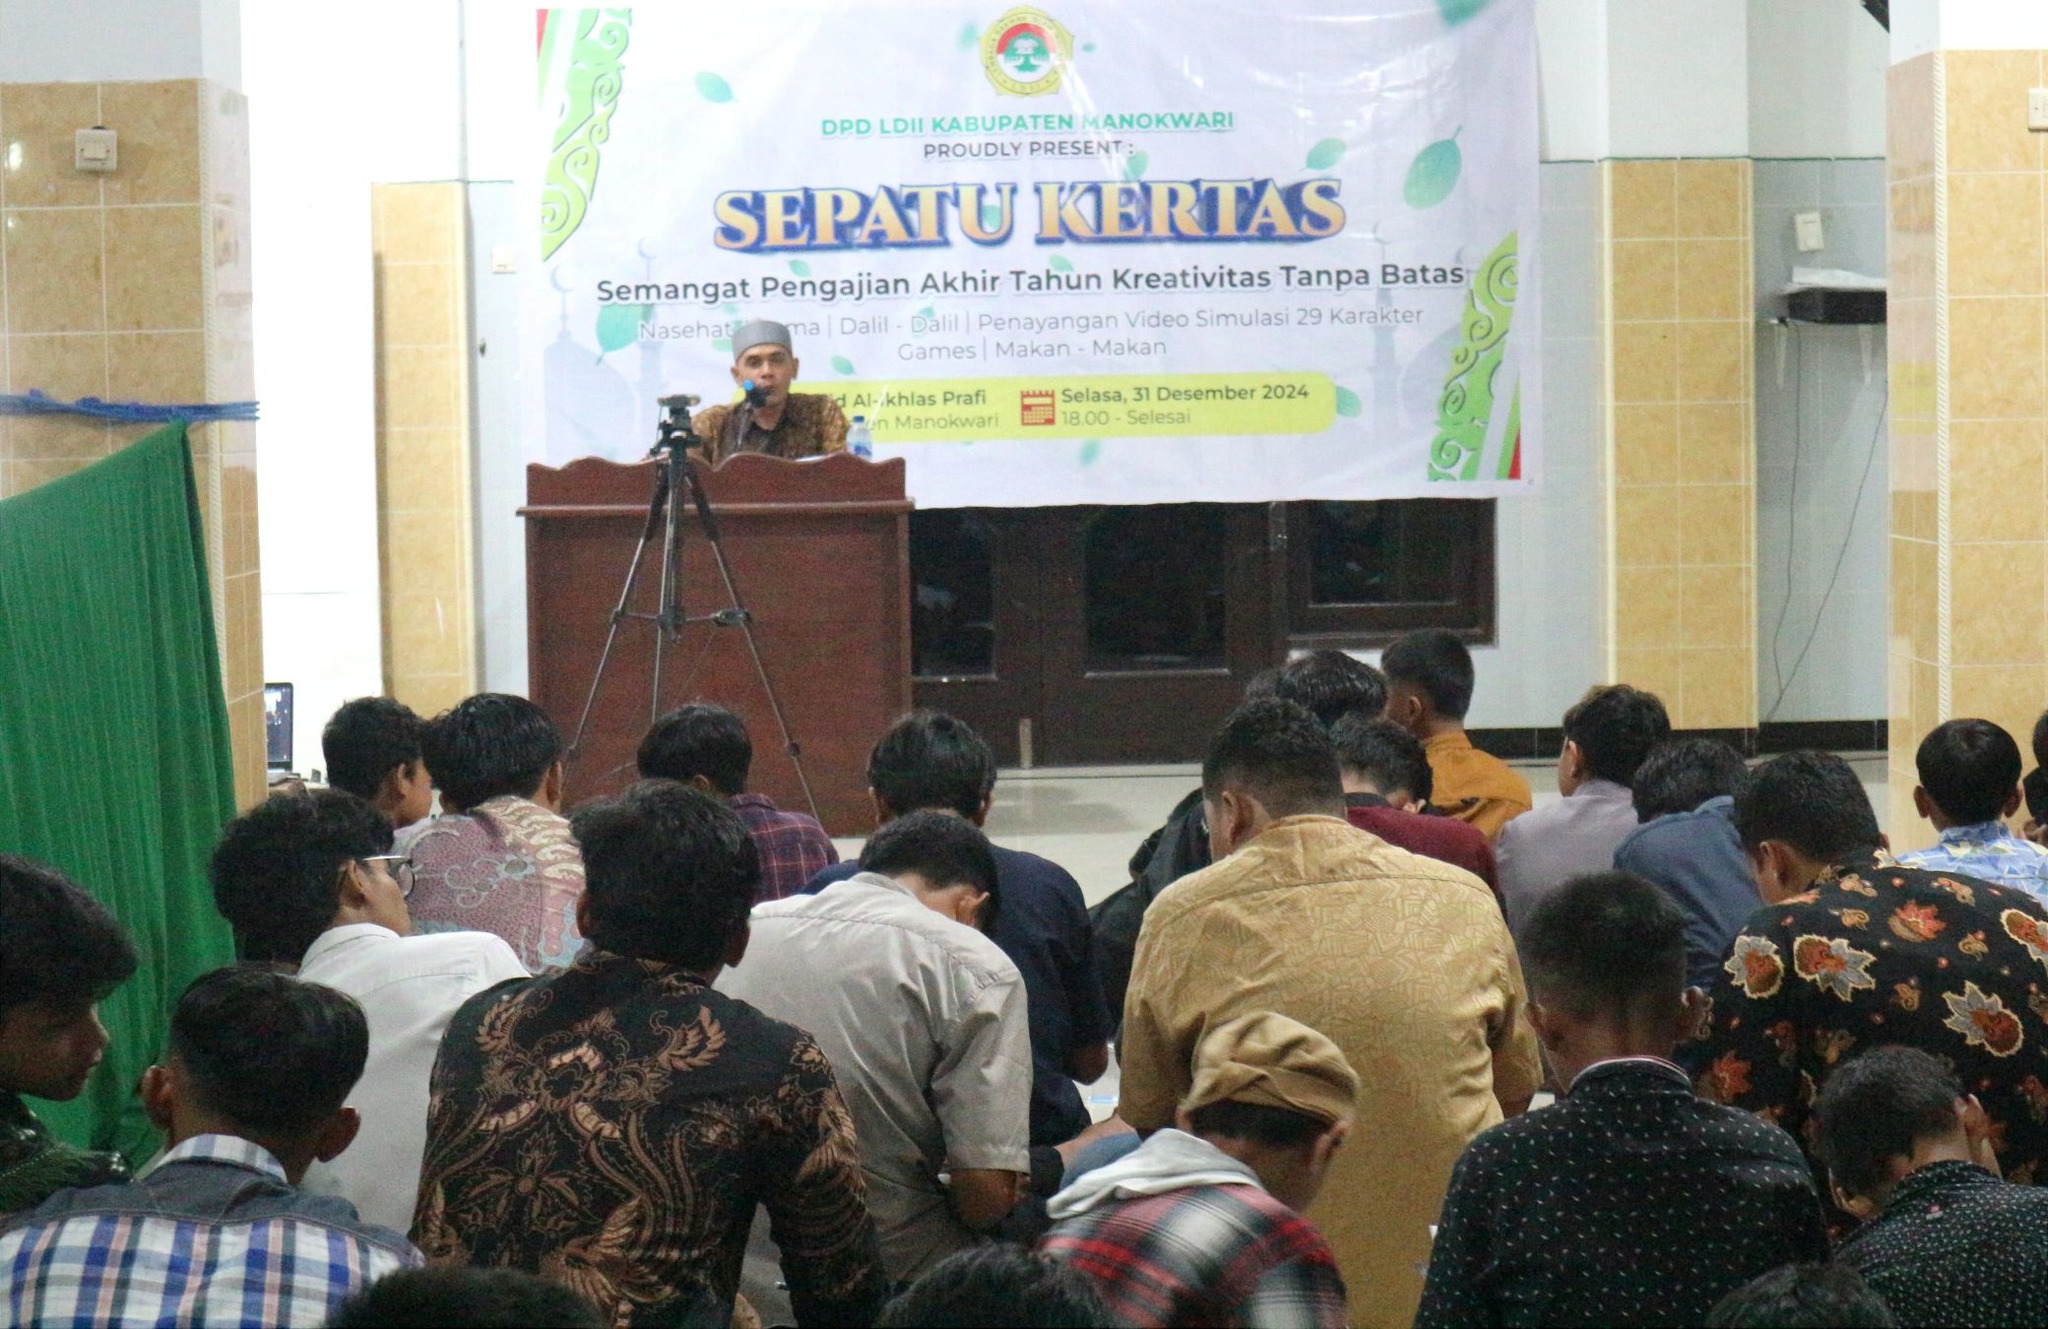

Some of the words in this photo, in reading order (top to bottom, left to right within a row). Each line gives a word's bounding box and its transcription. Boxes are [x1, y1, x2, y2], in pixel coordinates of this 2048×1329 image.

[821, 119, 870, 136] DPD
[879, 118, 924, 135] LDII
[932, 115, 1073, 133] KABUPATEN
[1082, 112, 1234, 130] MANOKWARI
[924, 142, 1021, 159] PROUDLY
[1030, 140, 1122, 157] PRESENT
[713, 183, 1017, 253] SEPATU
[1034, 177, 1347, 245] KERTAS
[597, 279, 750, 304] Semangat
[761, 273, 910, 301] Pengajian
[921, 270, 999, 293] Akhir
[1010, 269, 1101, 291] Tahun
[1113, 265, 1271, 289] Kreativitas
[1279, 266, 1370, 290] Tanpa
[1382, 263, 1464, 285] Batas
[640, 320, 733, 340] Nasehat
[841, 317, 888, 335] Dalil
[911, 316, 959, 334] Dalil
[979, 313, 1119, 335] Penayangan
[1125, 310, 1189, 329] Video
[1195, 308, 1290, 328] Simulasi
[1297, 308, 1322, 326] 29
[1330, 306, 1424, 325] Karakter
[898, 343, 976, 361] Games
[996, 339, 1070, 358] Makan
[1093, 338, 1167, 356] Makan
[943, 389, 987, 406] Prafi
[1061, 388, 1127, 405] Selasa,
[1132, 387, 1150, 401] 31
[1158, 385, 1256, 402] Desember
[1262, 384, 1309, 400] 2024
[896, 414, 999, 430] Manokwari
[1062, 412, 1109, 426] 18.00
[1127, 410, 1191, 425] Selesai
